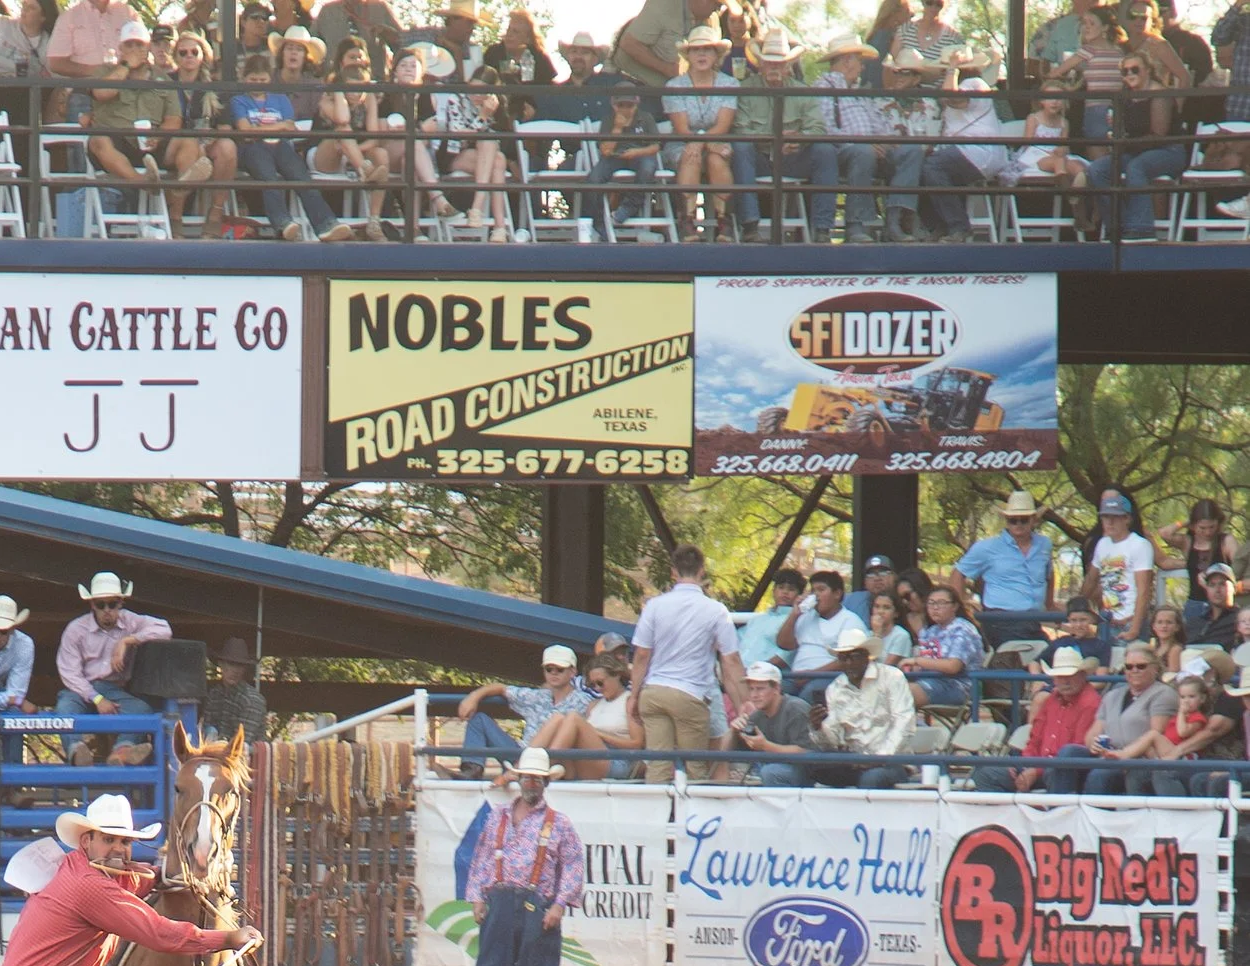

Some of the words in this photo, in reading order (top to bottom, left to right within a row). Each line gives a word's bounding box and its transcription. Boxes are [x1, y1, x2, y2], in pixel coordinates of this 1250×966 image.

[716, 277, 767, 288] PROUD
[772, 277, 856, 287] SUPPORTER
[862, 276, 883, 286] OF
[886, 276, 911, 286] THE
[916, 275, 967, 285] ANSON
[971, 274, 1029, 285] TIGERS!
[69, 301, 218, 351] CATTLE
[234, 301, 288, 351] CO
[349, 293, 592, 352] NOBLES
[345, 397, 455, 472] ROAD
[465, 335, 690, 428] CONSTRUCTION
[593, 408, 658, 420] ABILENE,
[604, 421, 648, 432] TEXAS
[436, 449, 689, 476] 325-677-6258
[710, 454, 860, 474] 325.668.0411
[884, 450, 1041, 471] 325.668.4804
[4, 717, 75, 729] REUNION
[680, 814, 850, 900] Lawrence
[853, 823, 932, 898] Hall
[1031, 835, 1098, 920] Big
[1099, 836, 1198, 906] Red's
